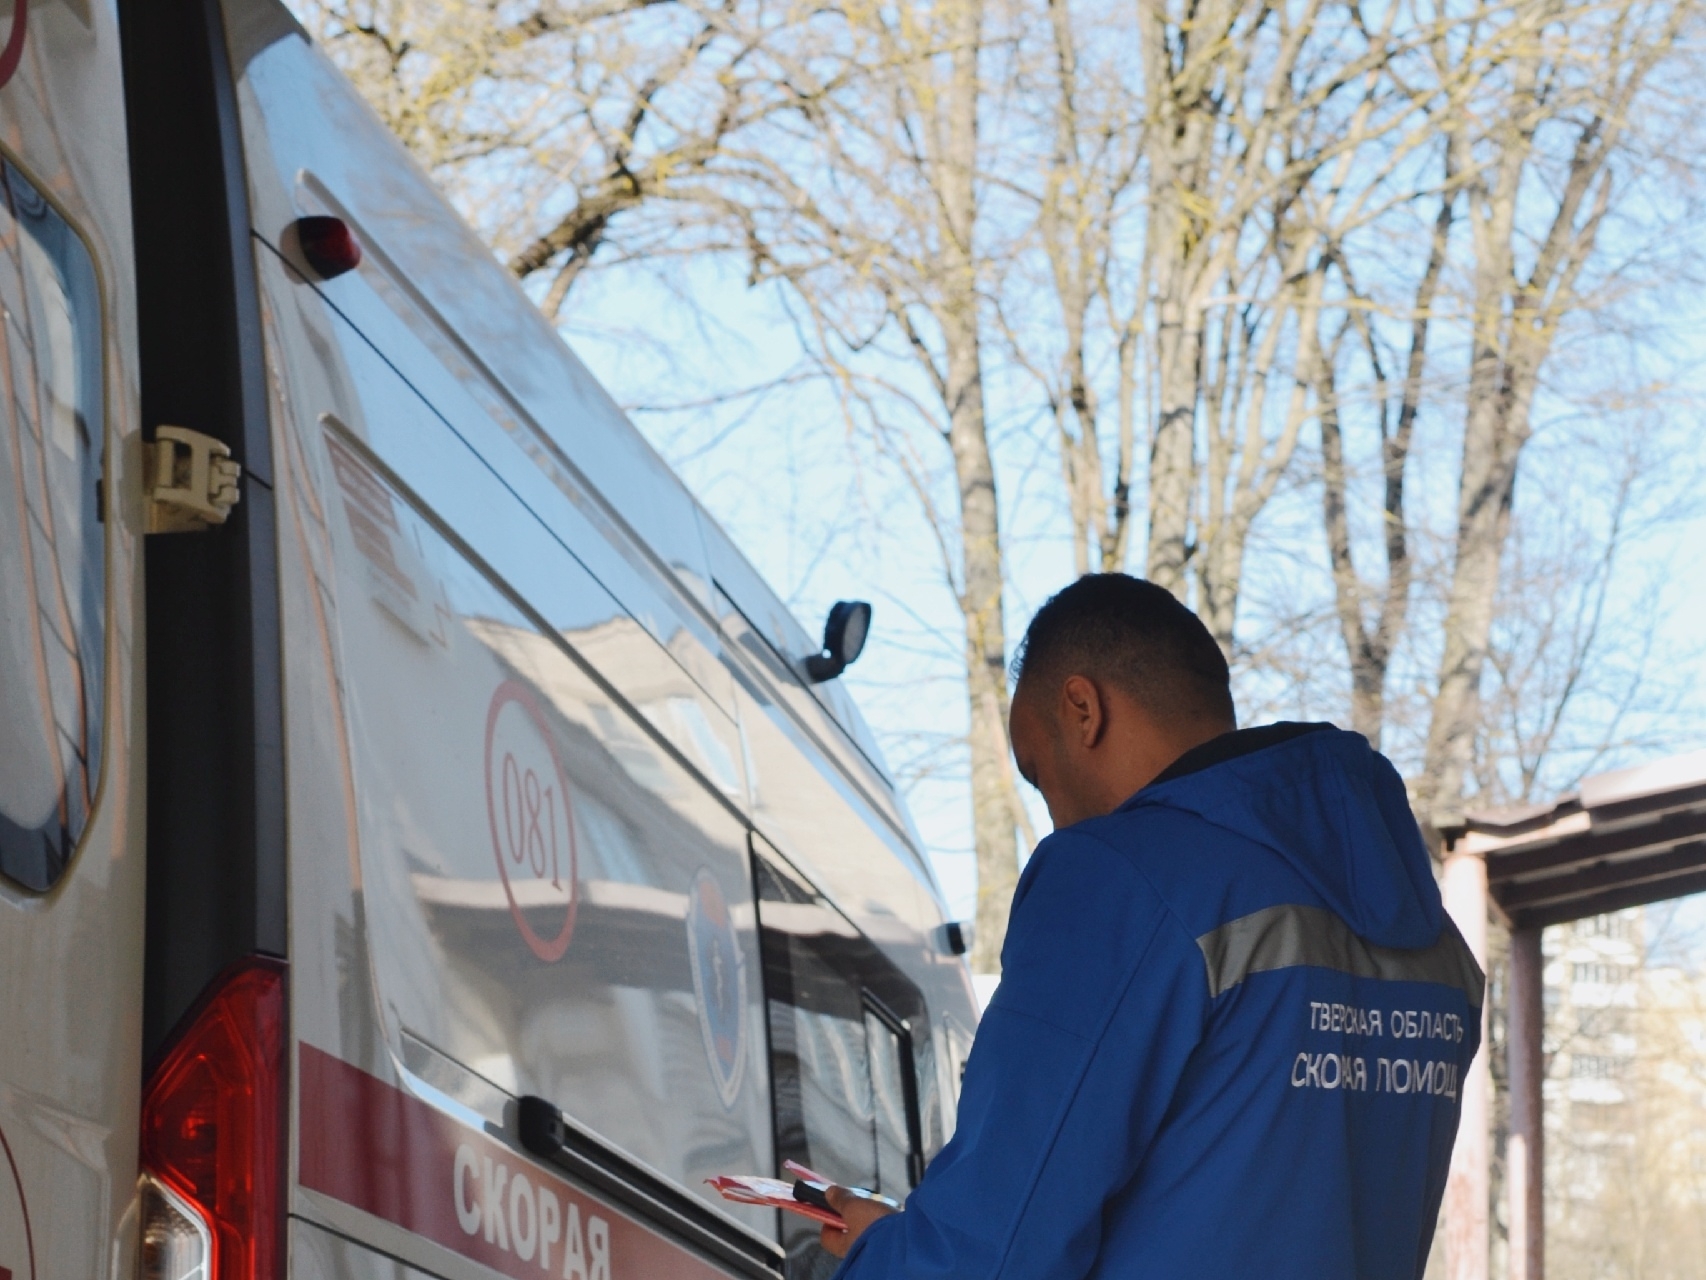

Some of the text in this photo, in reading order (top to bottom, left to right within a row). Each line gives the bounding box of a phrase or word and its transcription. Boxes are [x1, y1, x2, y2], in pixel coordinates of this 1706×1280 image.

[503, 751, 563, 893] 081
[1310, 1001, 1465, 1044] ТВЕРСКАЯ ОБЛАСТЬ
